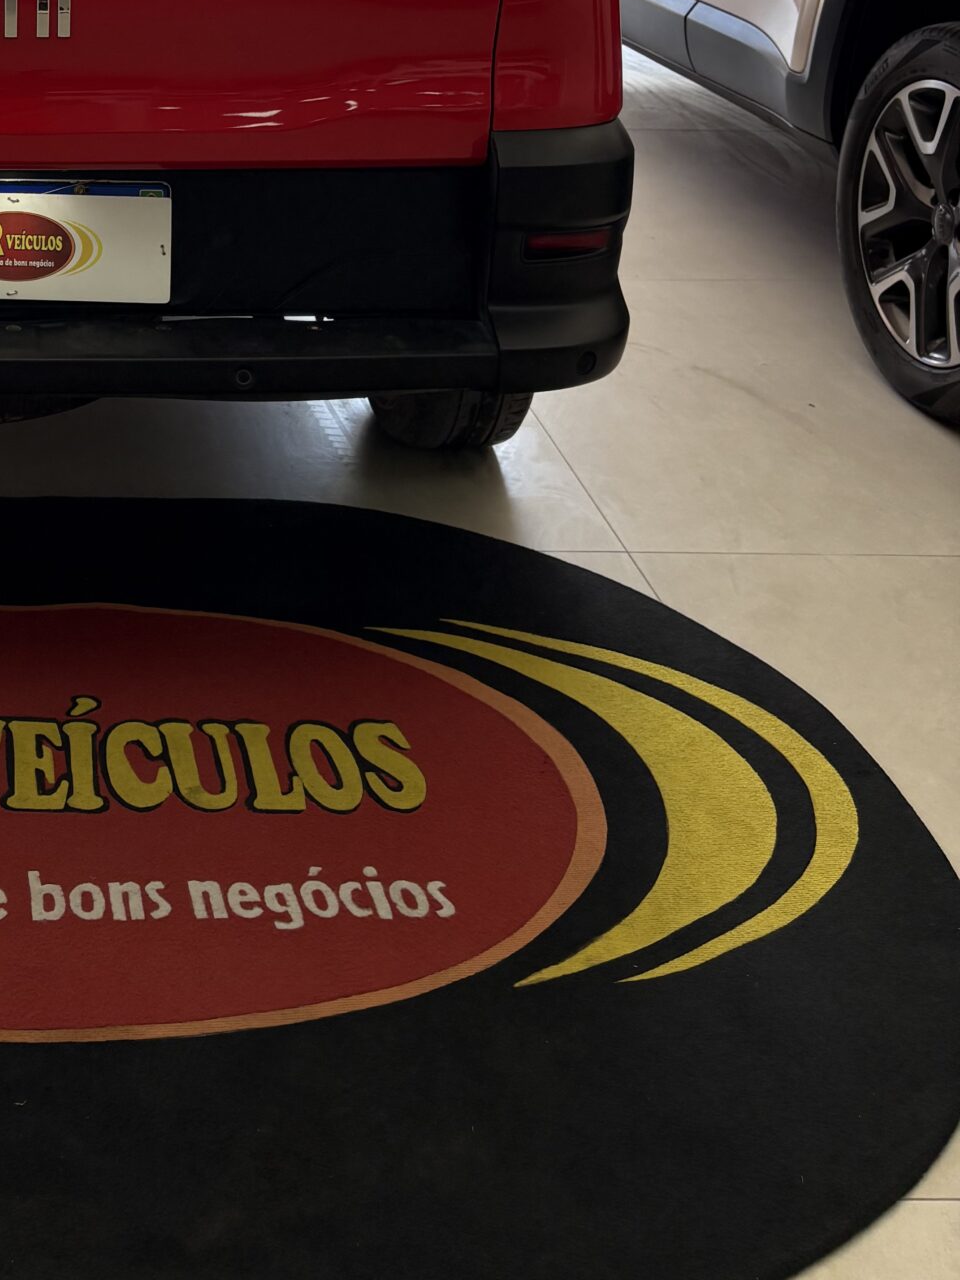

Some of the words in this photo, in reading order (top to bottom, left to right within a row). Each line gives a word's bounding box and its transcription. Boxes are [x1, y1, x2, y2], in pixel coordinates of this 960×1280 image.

[6, 230, 63, 251] VEÍCULOS
[5, 258, 12, 266] de
[14, 258, 27, 266] bons
[29, 258, 54, 268] negócios
[28, 870, 172, 922] bons
[188, 866, 456, 930] negócios
